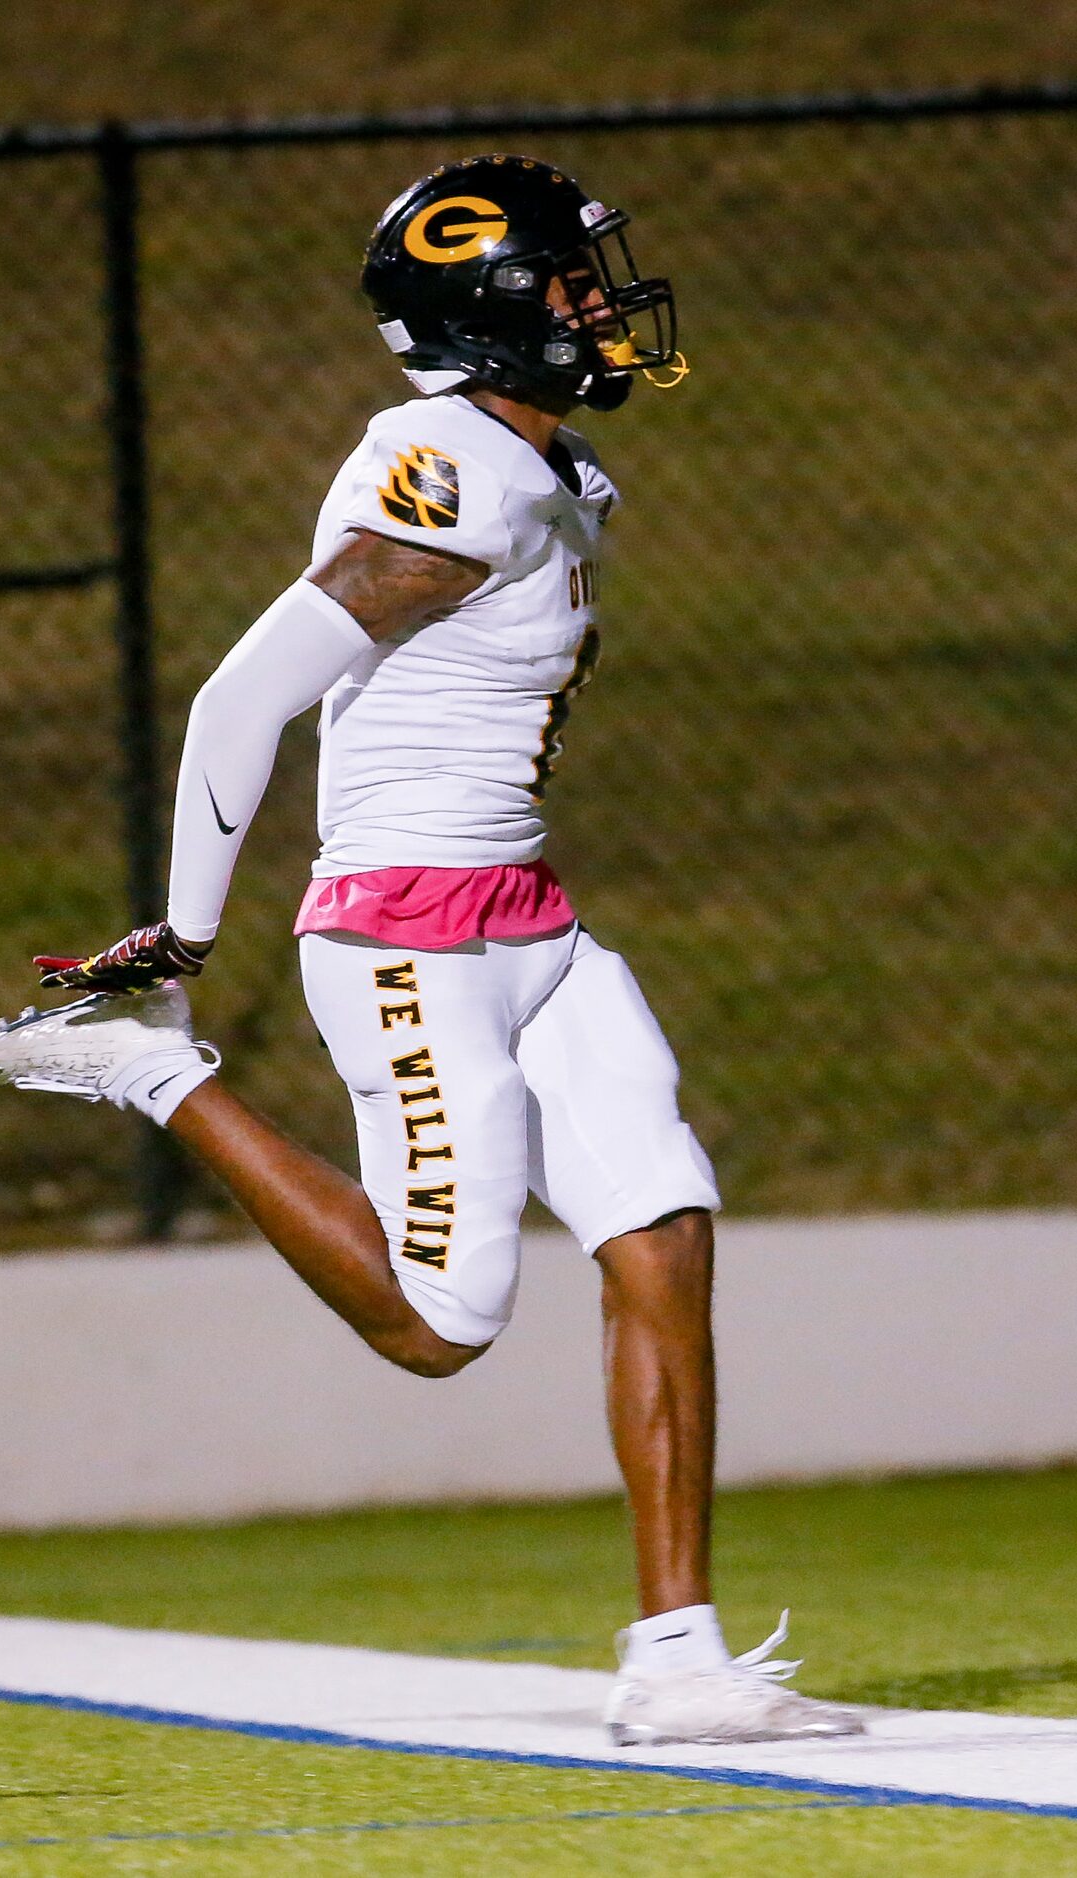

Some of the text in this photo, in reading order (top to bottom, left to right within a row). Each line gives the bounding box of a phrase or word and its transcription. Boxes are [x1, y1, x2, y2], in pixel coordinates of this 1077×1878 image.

[404, 196, 508, 263] G
[373, 960, 457, 1272] WE WILL WIN
